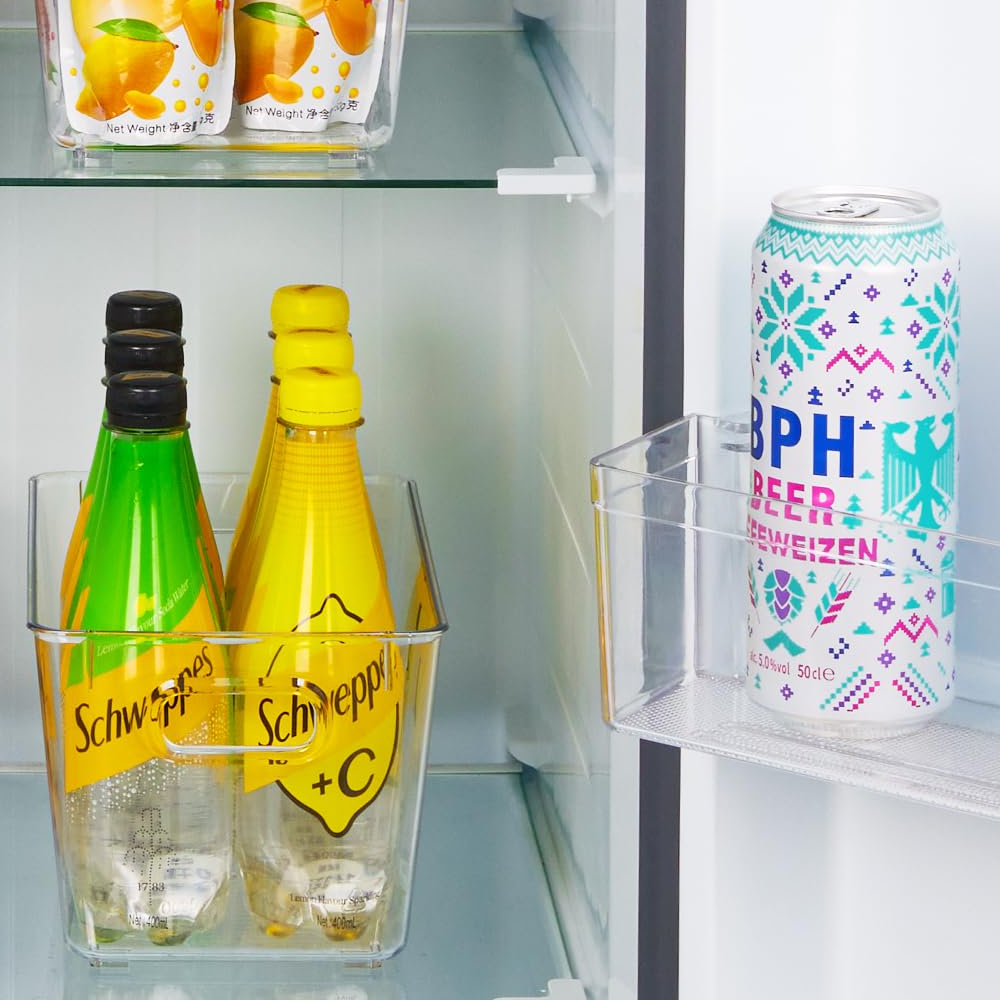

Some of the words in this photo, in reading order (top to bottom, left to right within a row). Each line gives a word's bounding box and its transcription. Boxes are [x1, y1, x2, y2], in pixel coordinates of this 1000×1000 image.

[106, 123, 125, 134] Net
[127, 123, 167, 136] Weight
[265, 107, 303, 120] Weight
[751, 395, 855, 478] BPH
[750, 469, 836, 526] BEER
[75, 646, 213, 753] Schwppes
